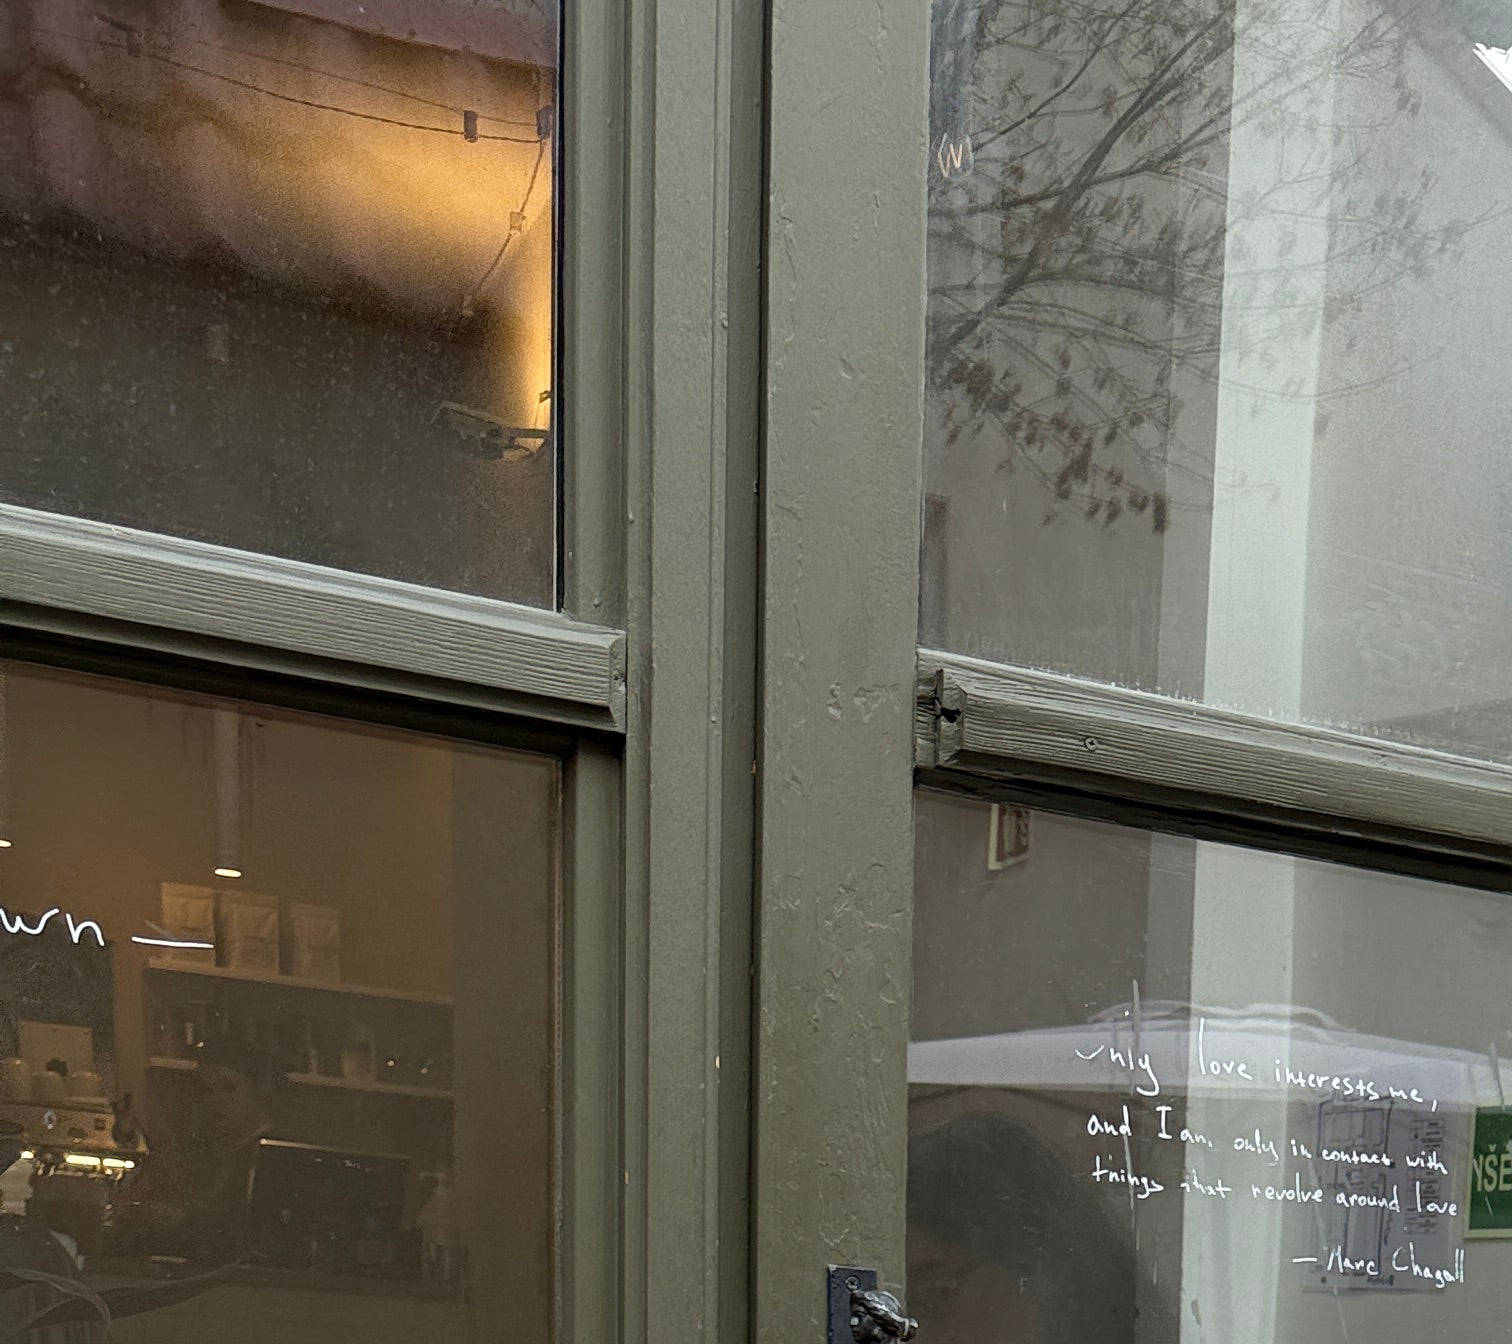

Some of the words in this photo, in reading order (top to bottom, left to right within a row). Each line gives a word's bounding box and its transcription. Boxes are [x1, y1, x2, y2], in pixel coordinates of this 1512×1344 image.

[1199, 1018, 1253, 1081] love
[1273, 1059, 1380, 1101] interests
[1087, 1105, 1132, 1137] and
[1155, 1105, 1173, 1140] I
[1234, 1128, 1279, 1165] only
[1290, 1138, 1312, 1159] in
[1321, 1146, 1393, 1166] contact
[1405, 1150, 1449, 1175] with
[1251, 1171, 1324, 1204] revolve
[1336, 1184, 1401, 1214] around
[1415, 1180, 1457, 1216] love
[1326, 1244, 1379, 1277] Marc
[1392, 1241, 1465, 1289] Chagall
